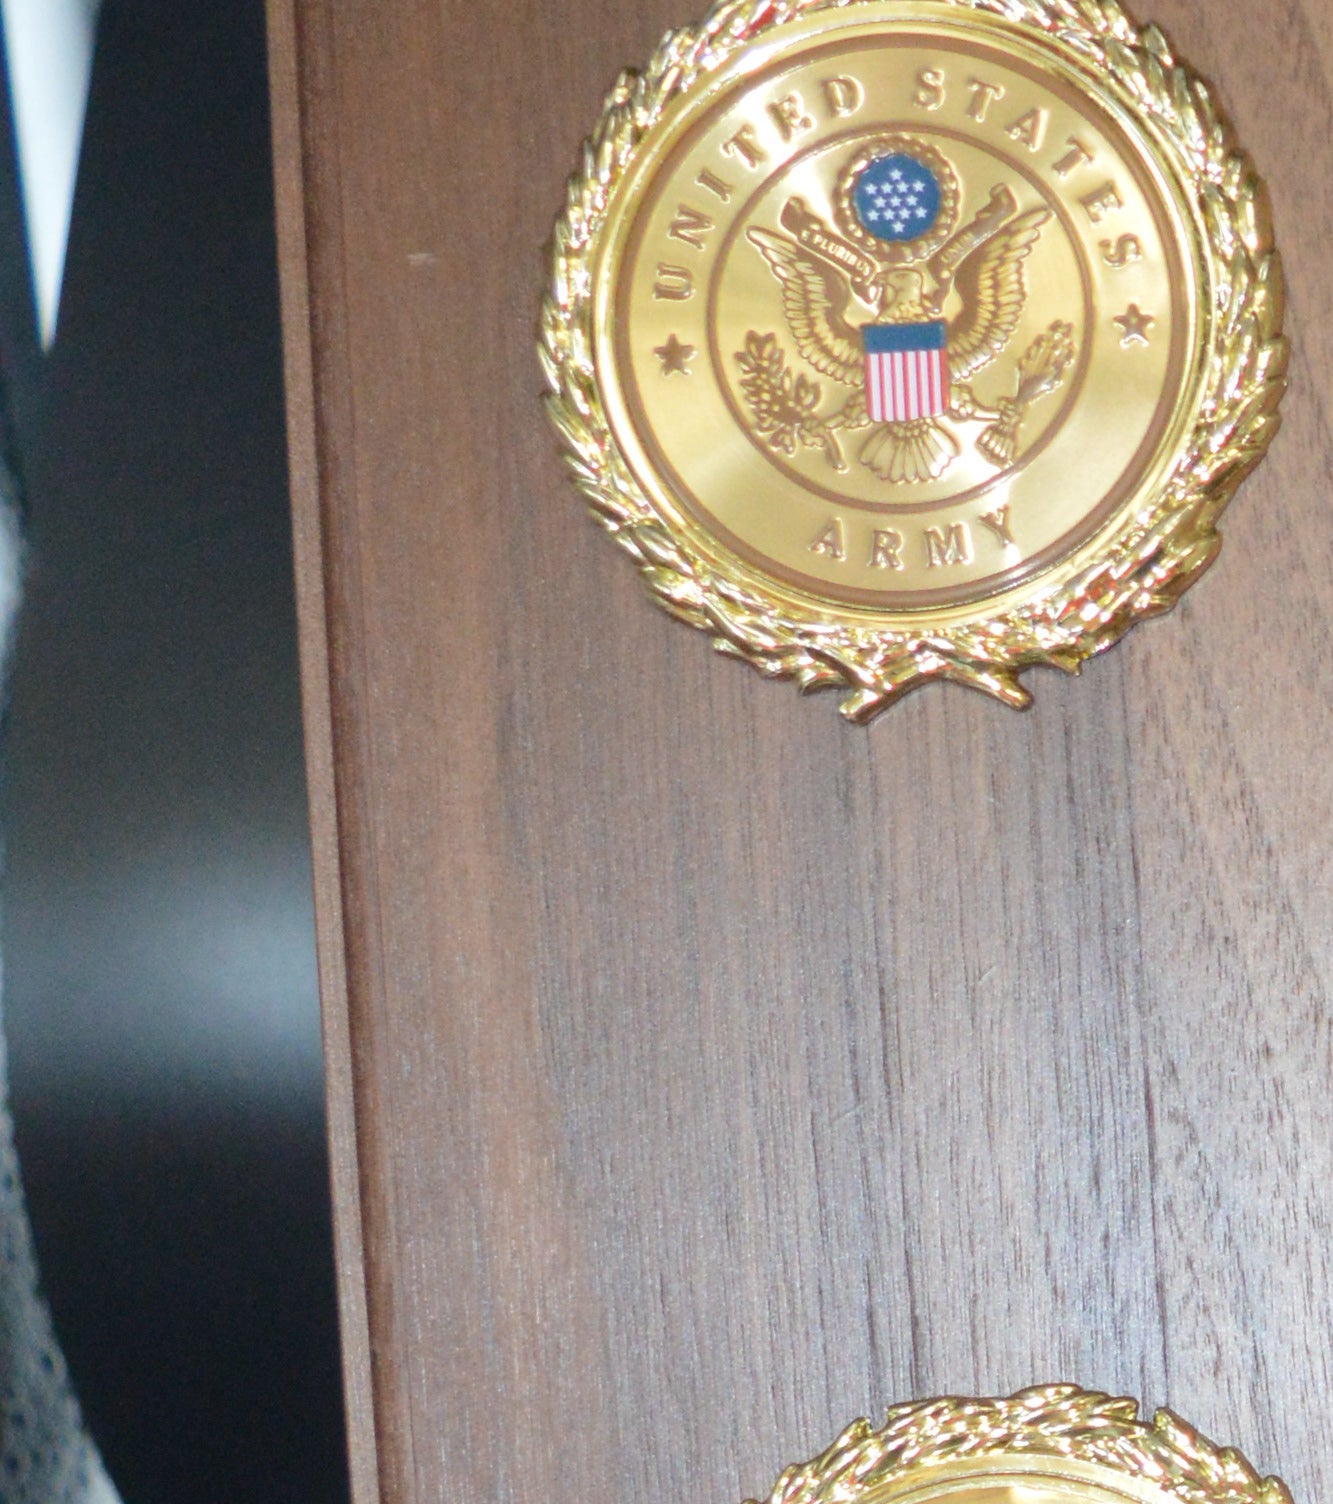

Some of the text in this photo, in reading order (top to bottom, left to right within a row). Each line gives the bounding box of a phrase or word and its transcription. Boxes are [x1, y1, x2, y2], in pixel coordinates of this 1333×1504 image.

[655, 67, 1140, 301] UNITED STATES
[811, 506, 1014, 571] ARMY
